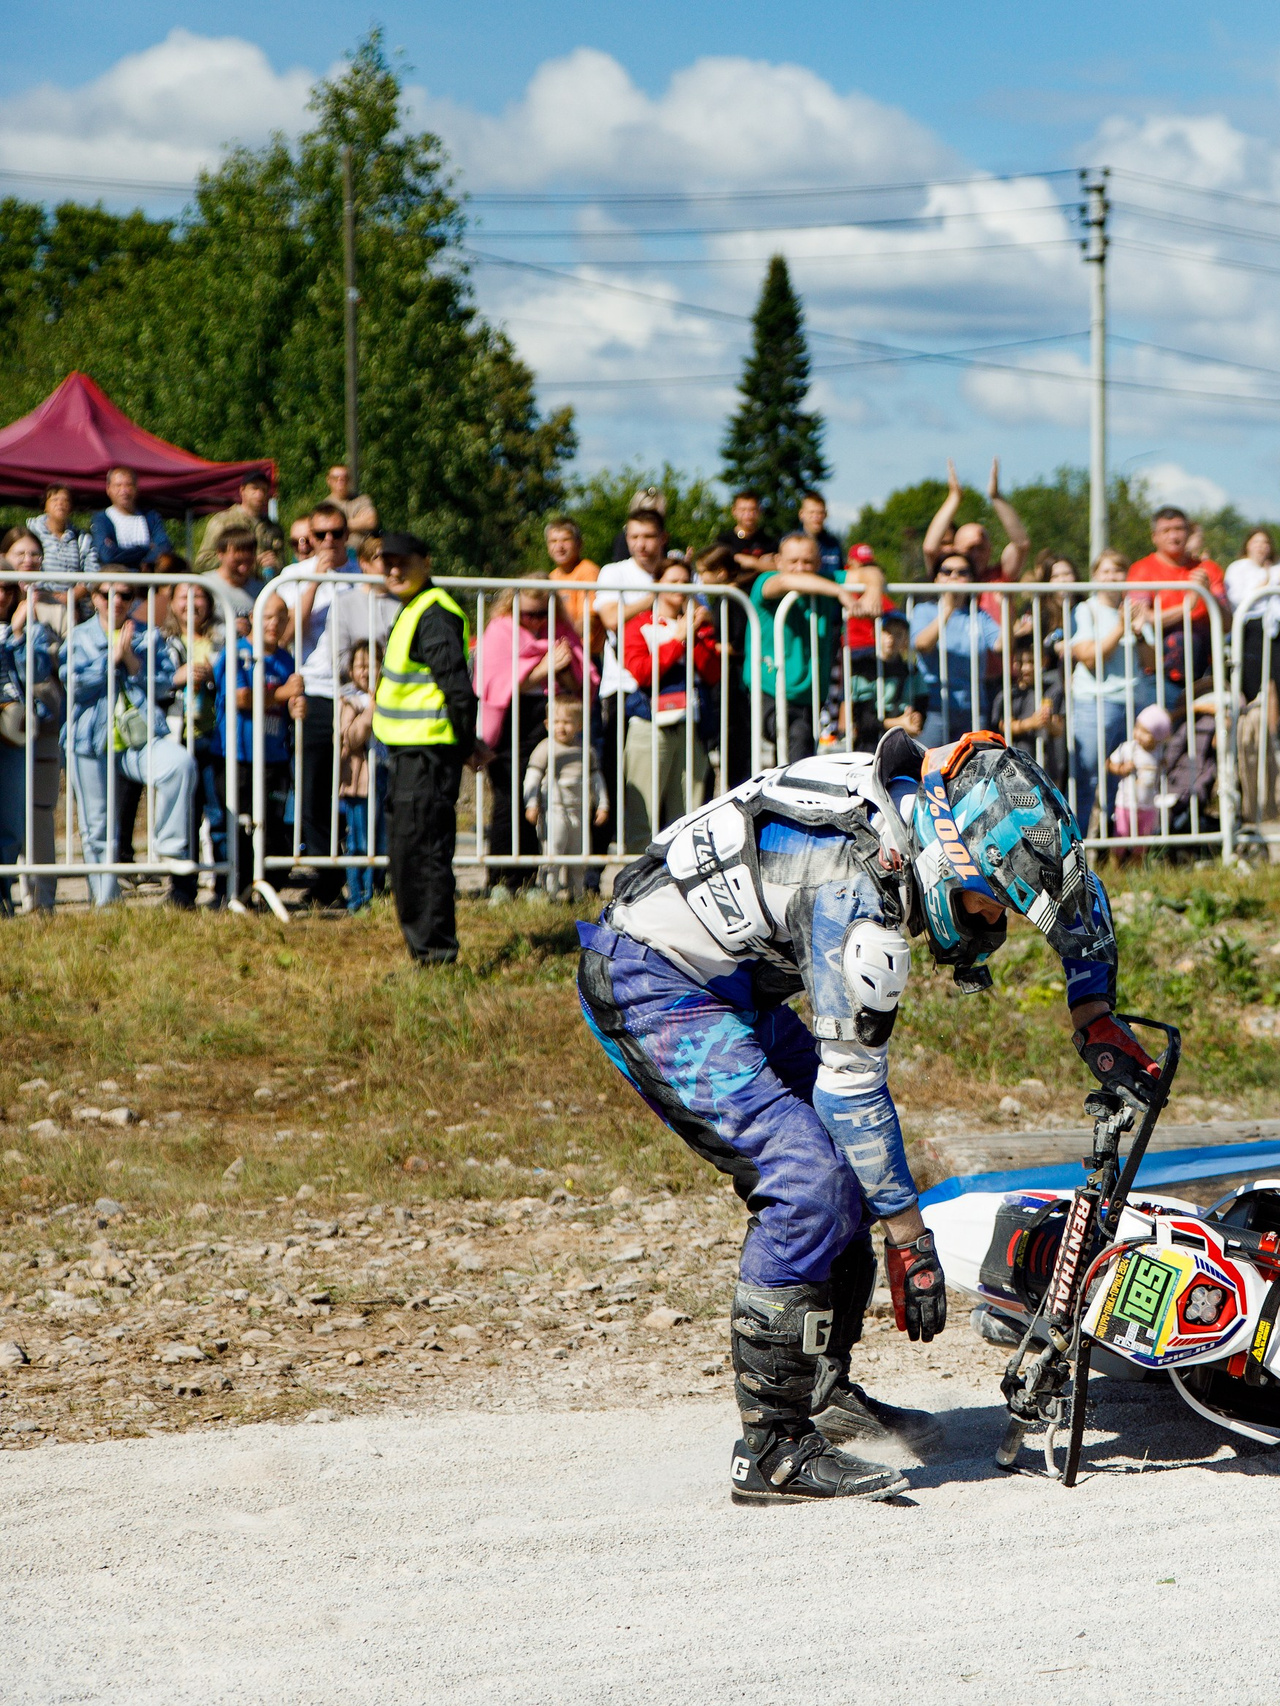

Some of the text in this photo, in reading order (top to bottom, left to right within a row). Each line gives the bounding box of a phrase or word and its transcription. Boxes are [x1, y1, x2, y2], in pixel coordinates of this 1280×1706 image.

[925, 785, 980, 881] 100%
[1081, 932, 1115, 957] LS2
[832, 1099, 901, 1198] FOX
[1051, 1196, 1091, 1315] RENTHAL
[1123, 1258, 1168, 1323] 185
[802, 1309, 834, 1355] G
[1157, 1342, 1216, 1365] RIEJU
[732, 1455, 751, 1482] G
